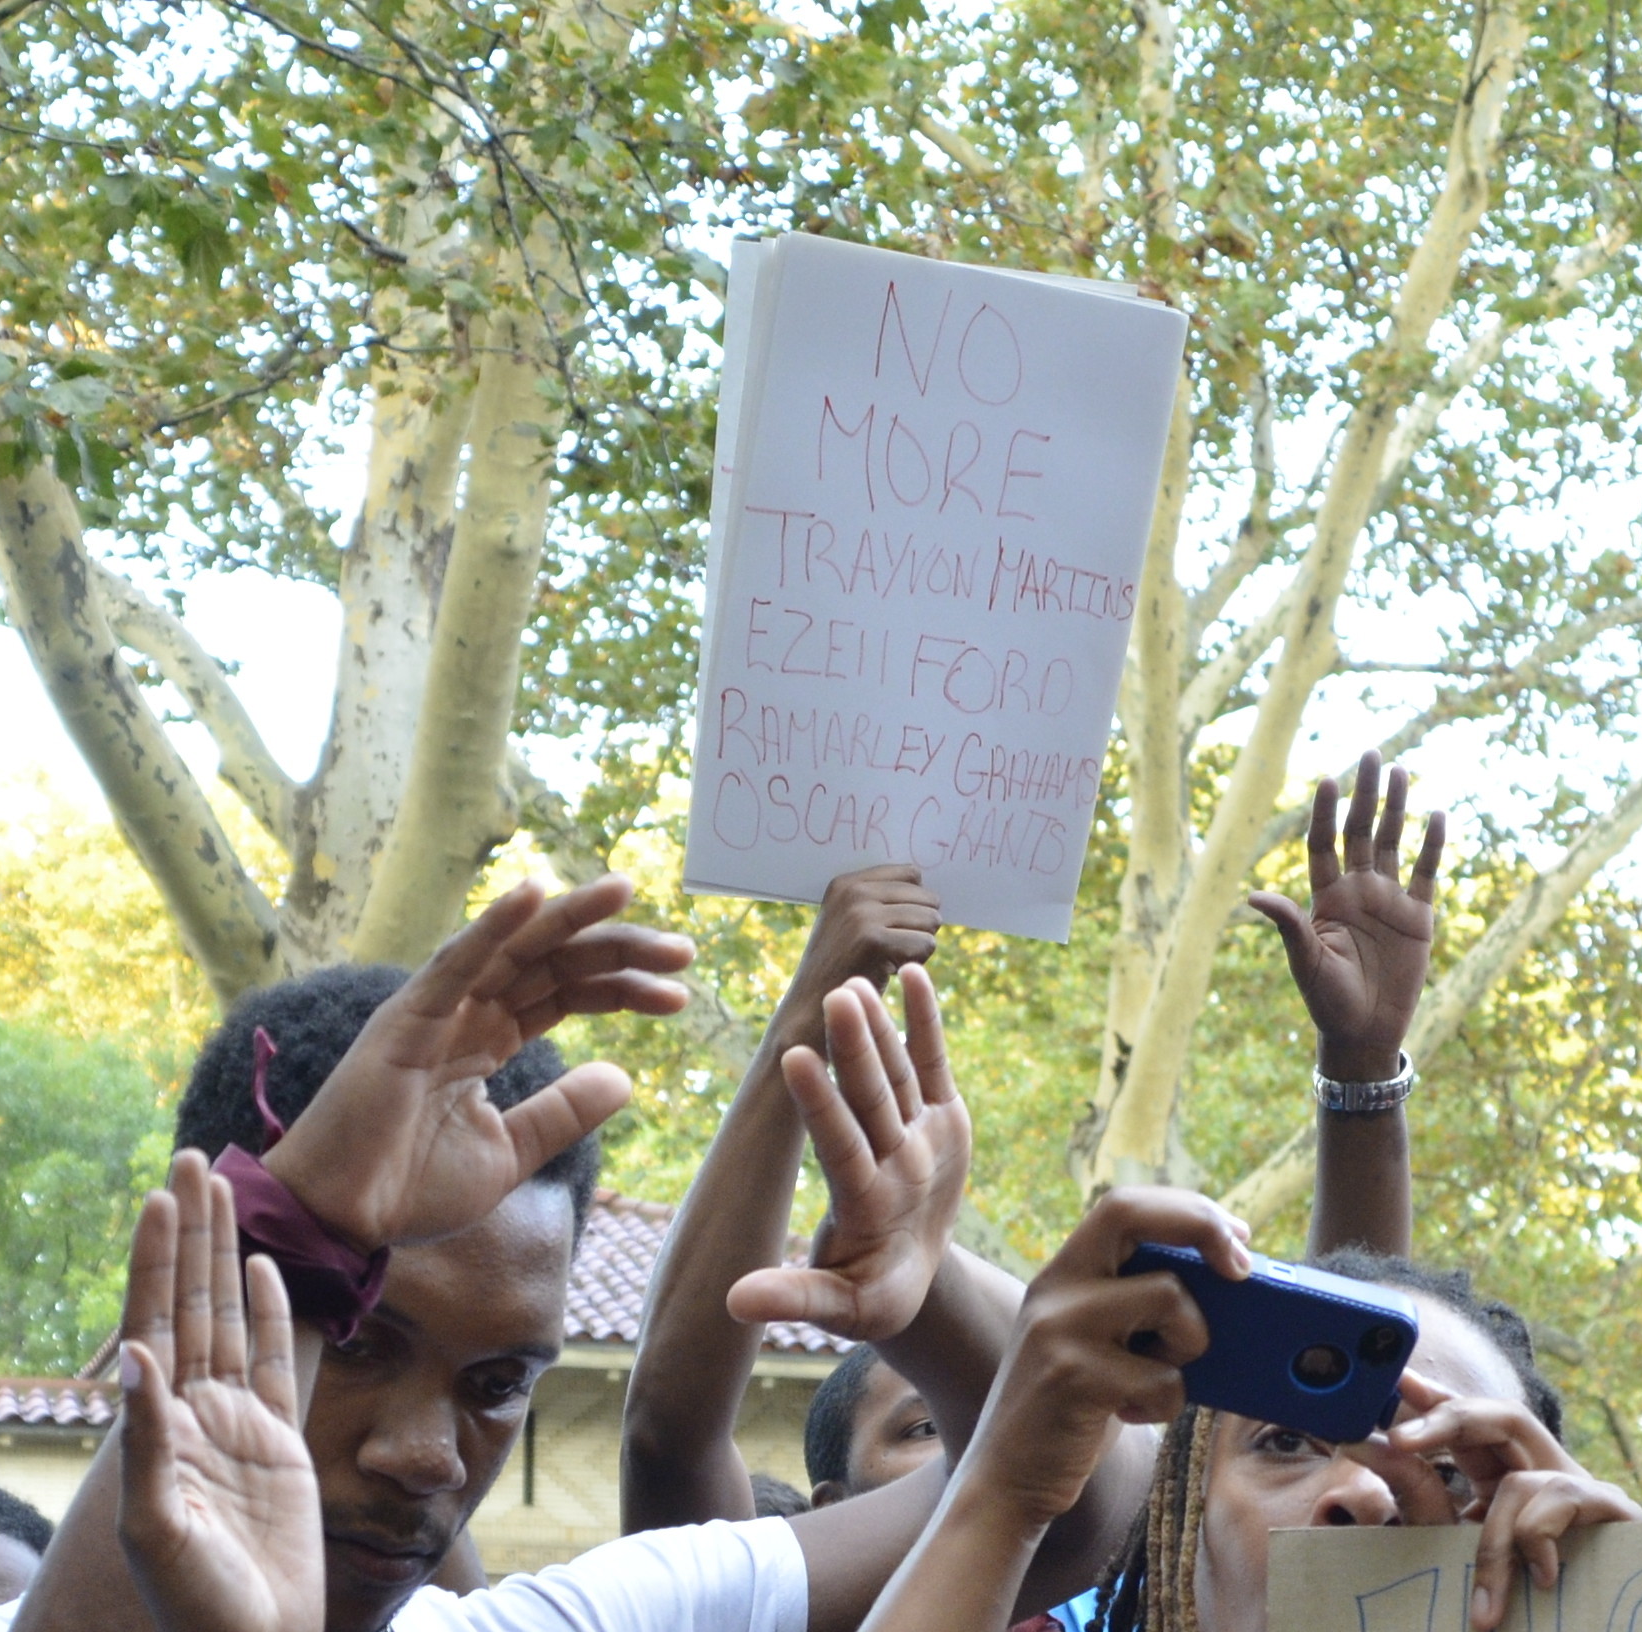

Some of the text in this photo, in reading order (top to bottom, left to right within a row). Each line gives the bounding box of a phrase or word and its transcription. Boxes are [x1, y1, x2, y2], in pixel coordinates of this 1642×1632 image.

[875, 281, 1022, 405] NO
[817, 394, 1050, 521] MORE
[745, 505, 1134, 621] TRAYVON MARTINS
[911, 634, 1073, 716] FORD
[717, 688, 1099, 810] RAMARLEY GRAHAMS
[713, 769, 1067, 876] OSCAR GRANTS
